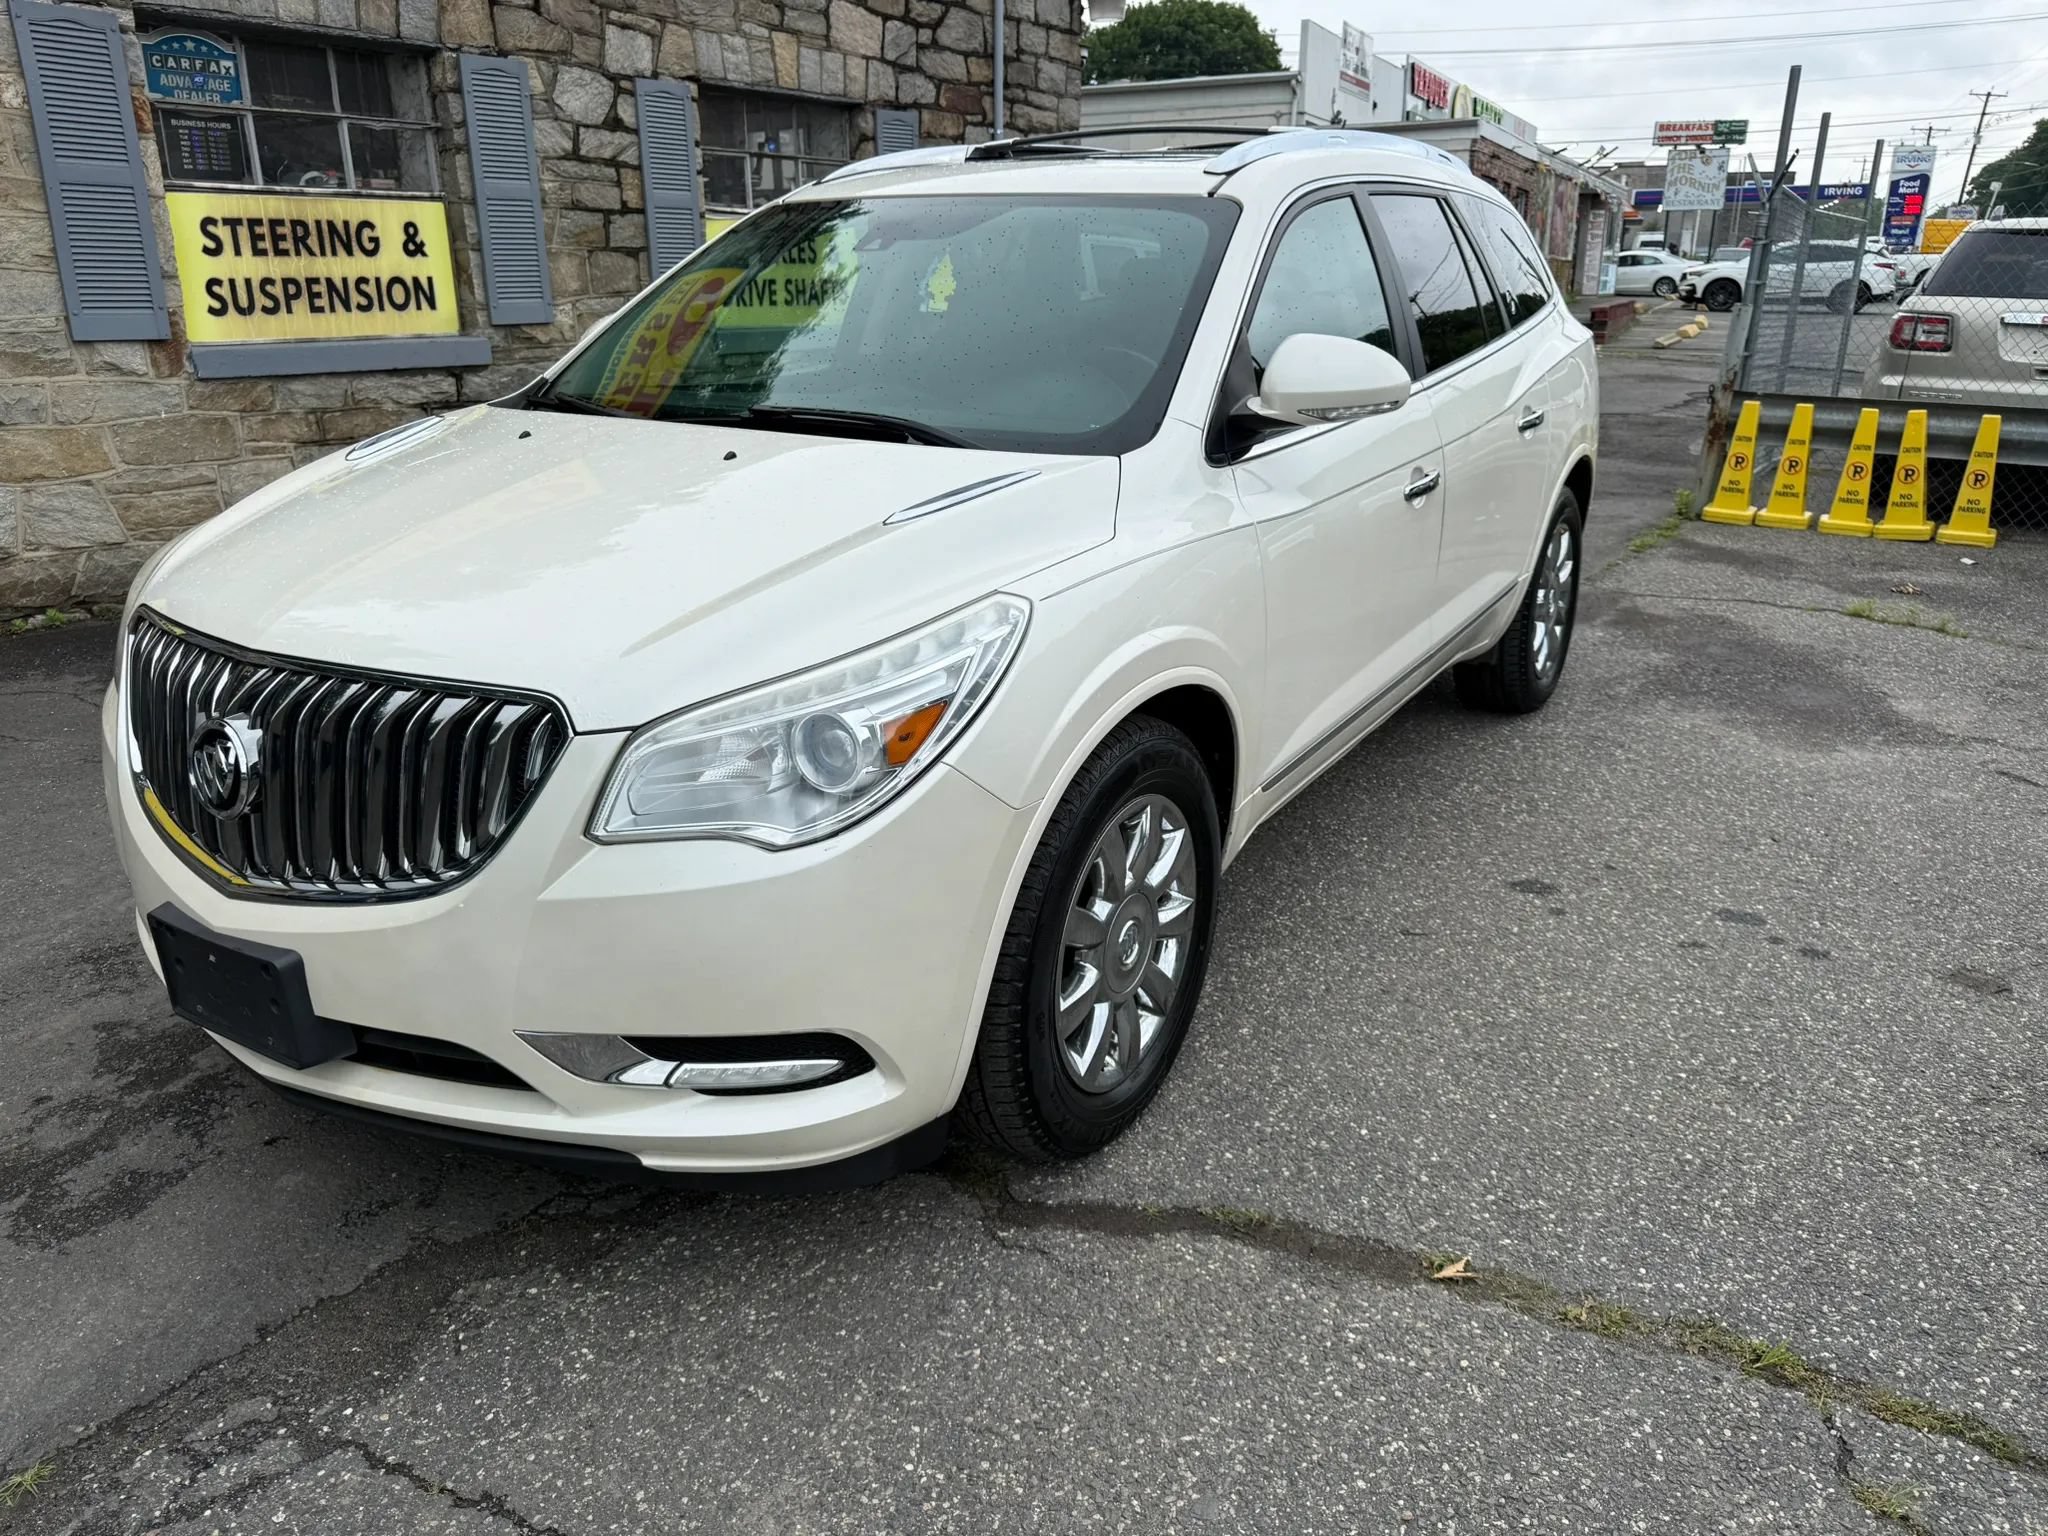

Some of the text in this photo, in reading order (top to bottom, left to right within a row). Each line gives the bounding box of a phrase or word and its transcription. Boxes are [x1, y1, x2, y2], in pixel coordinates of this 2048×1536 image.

[151, 55, 232, 76] CARFAX
[160, 73, 232, 92] ADVAAGE
[174, 89, 221, 103] DEALER
[171, 118, 232, 130] BUSINESS HOURS
[1658, 123, 1714, 132] BREAKFAST
[1896, 155, 1931, 164] IRVING
[1824, 187, 1863, 196] IRVING
[200, 216, 429, 258] STEERING &
[205, 276, 437, 317] SUSPENSION
[1958, 506, 1986, 514] PARKING
